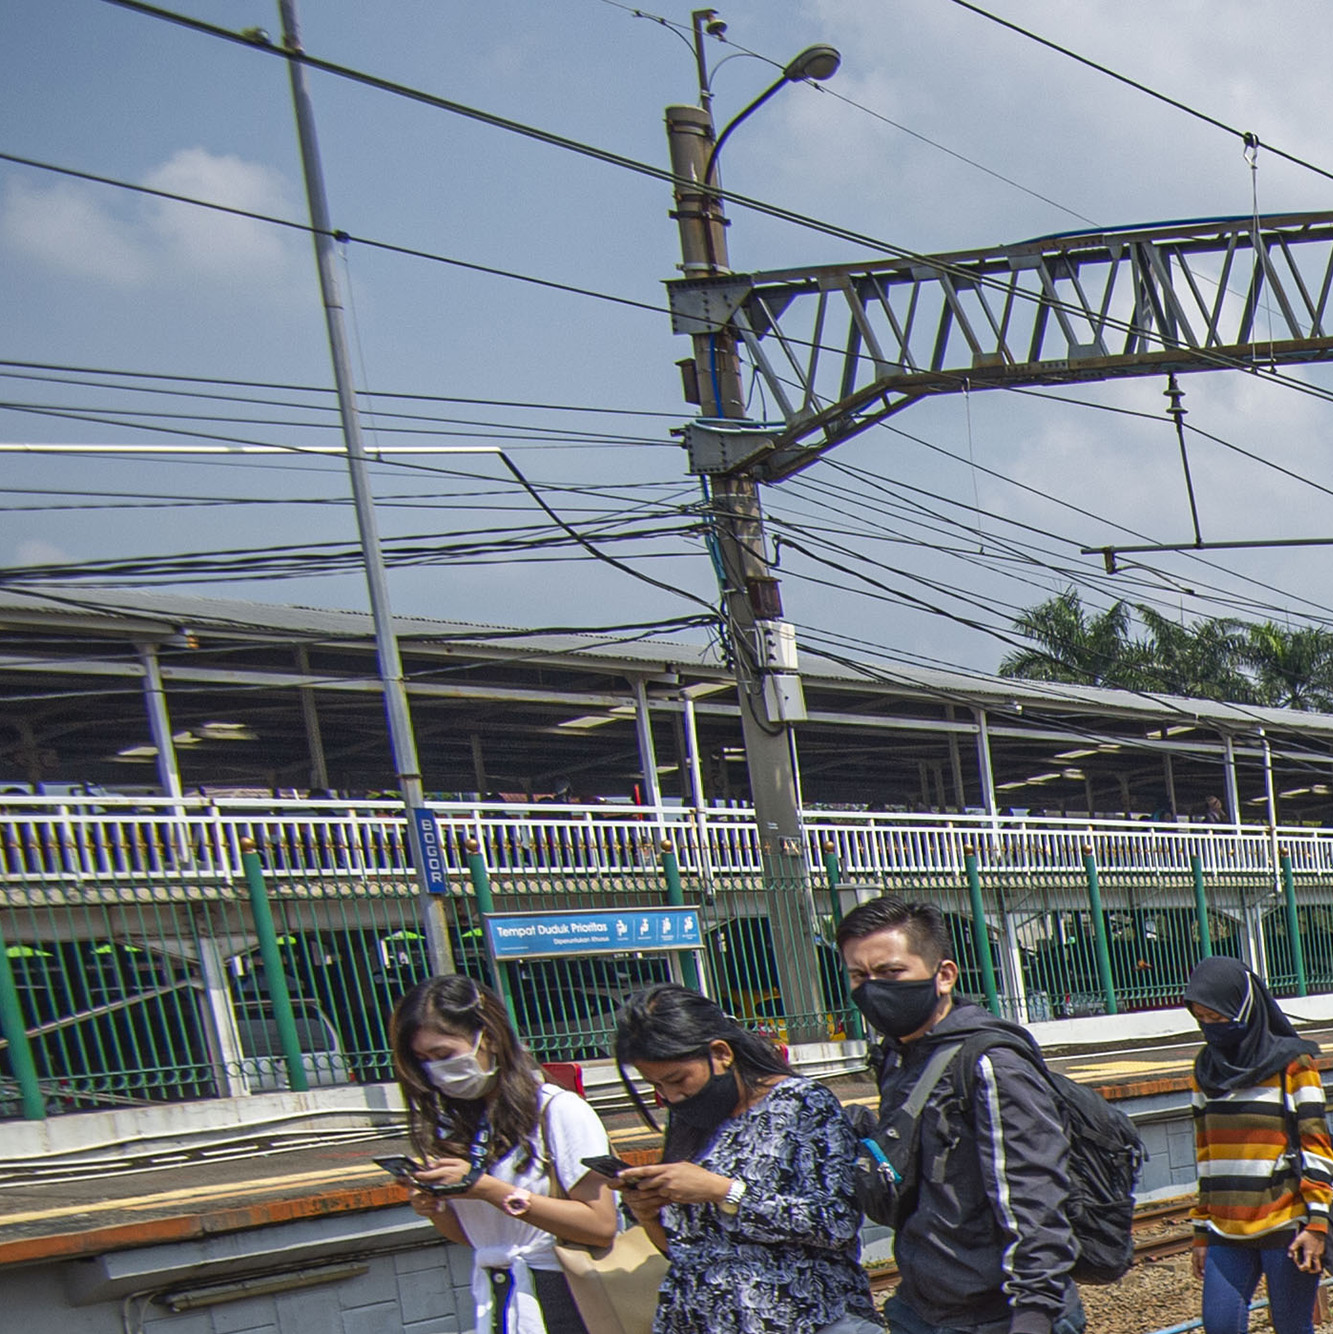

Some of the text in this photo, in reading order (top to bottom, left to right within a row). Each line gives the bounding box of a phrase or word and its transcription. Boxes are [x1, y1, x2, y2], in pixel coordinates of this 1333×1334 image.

[421, 819, 443, 883] BOGOR
[496, 919, 609, 939] Tempat Duduk Prioritas
